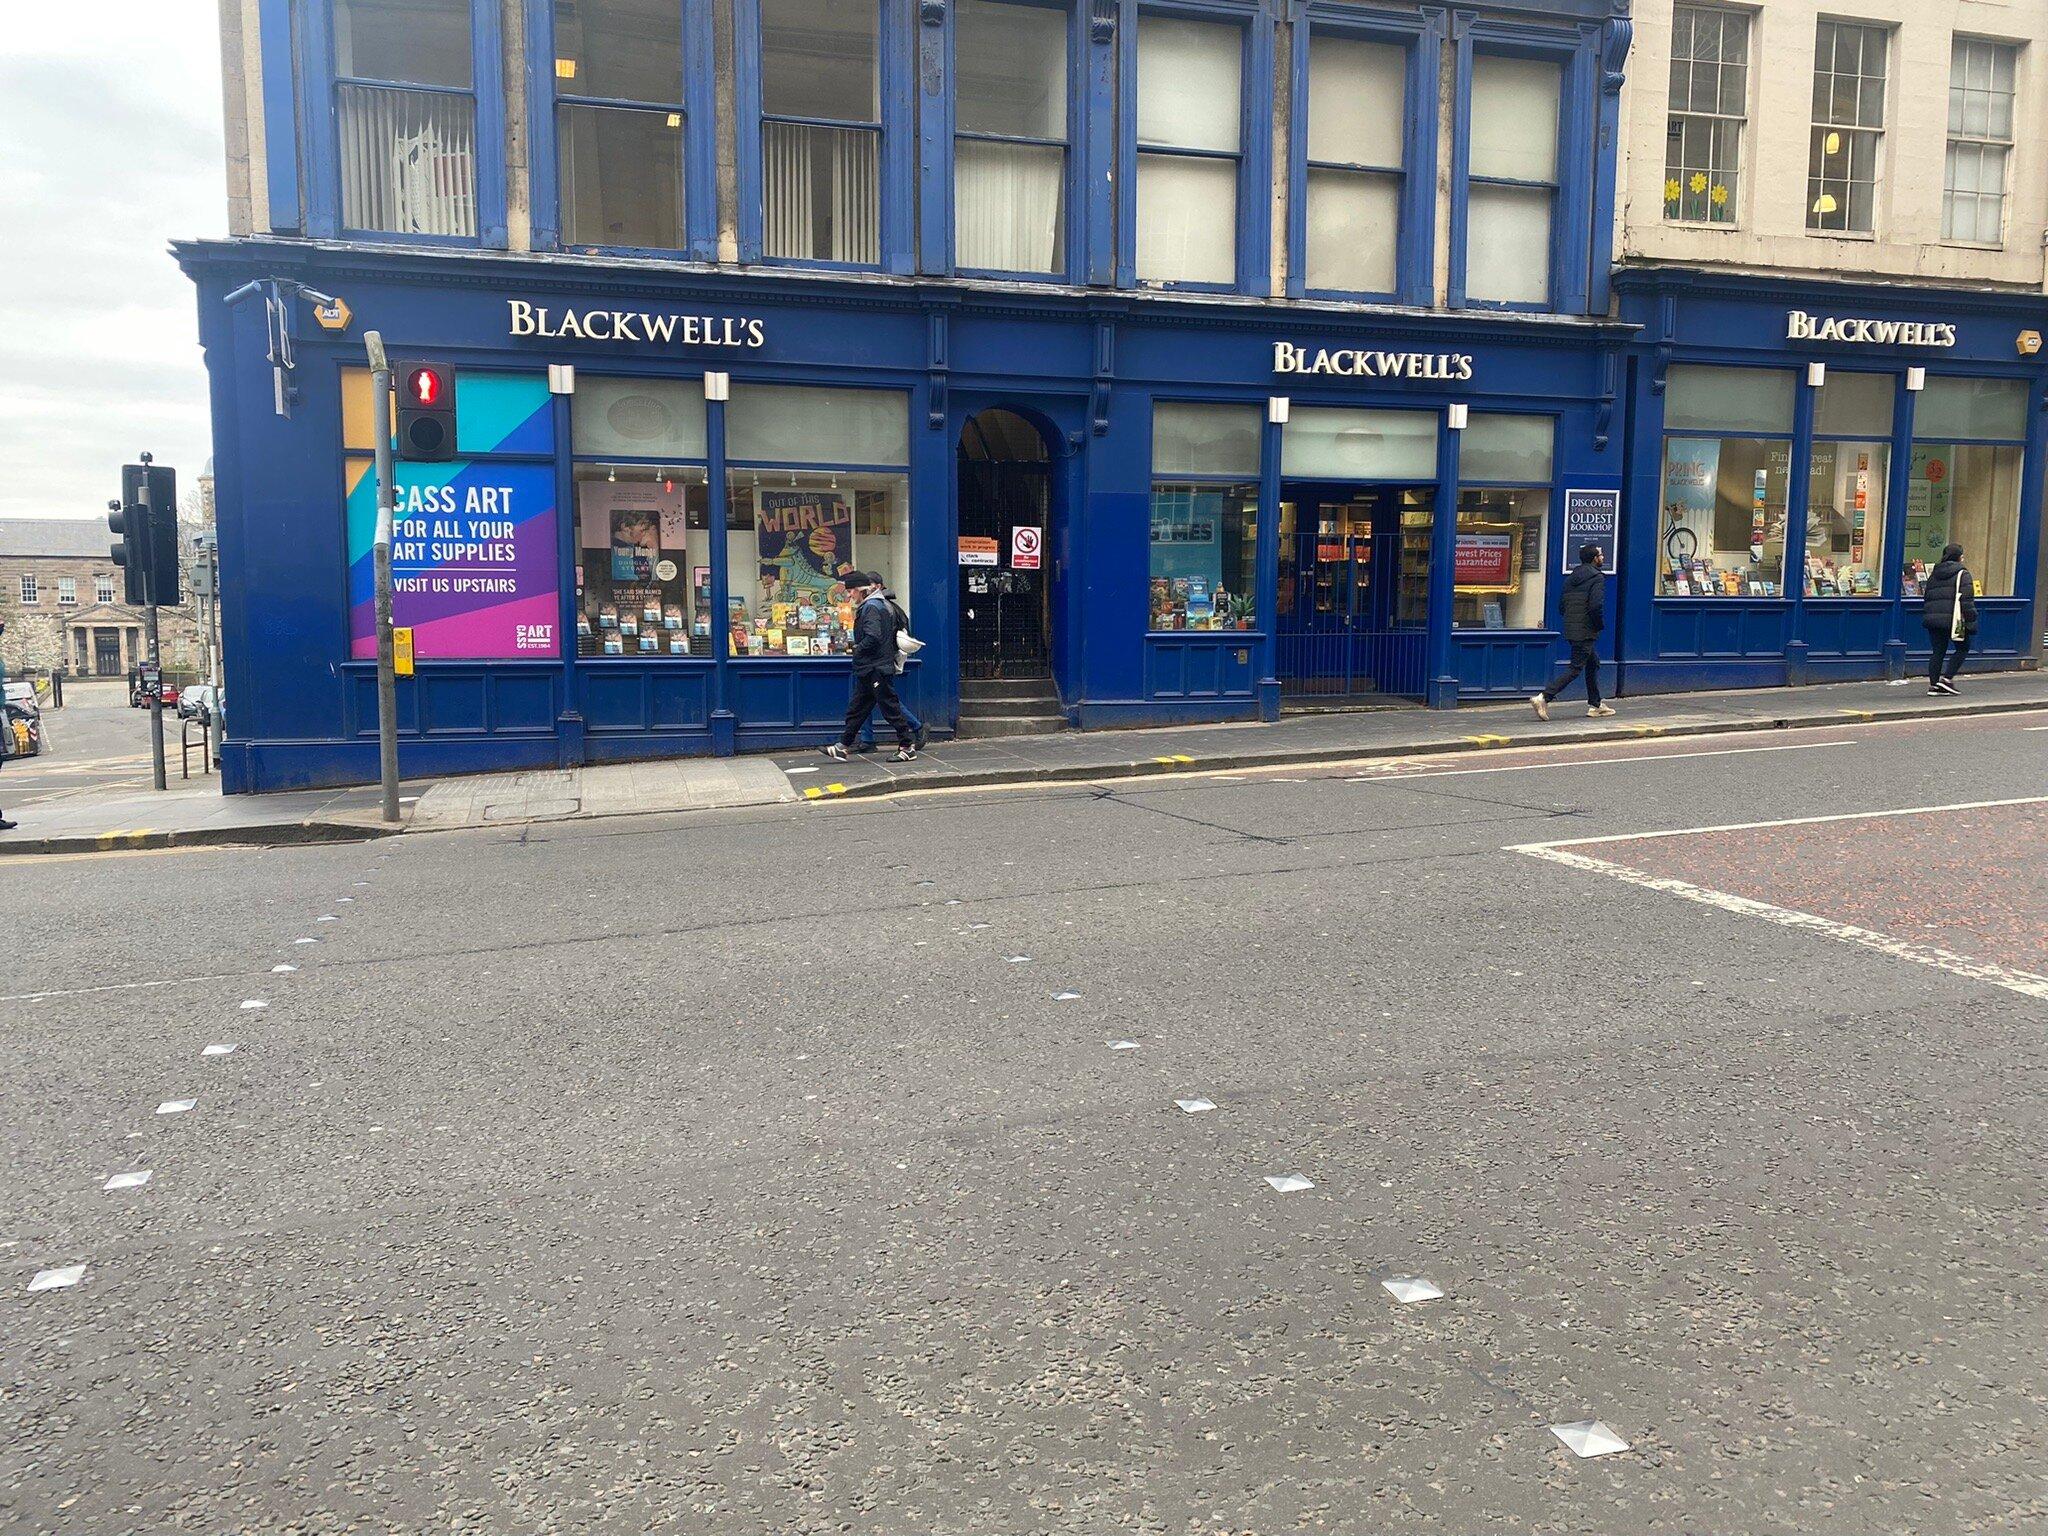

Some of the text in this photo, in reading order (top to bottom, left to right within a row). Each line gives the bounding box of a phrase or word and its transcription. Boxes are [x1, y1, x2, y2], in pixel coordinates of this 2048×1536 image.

[507, 299, 764, 348] BLACKWELL'S
[1786, 310, 1957, 347] BLACKWELL'S
[1272, 341, 1473, 380] BLACKWELL'S
[1771, 452, 1834, 463] Fin reat
[1810, 466, 1826, 475] ad!
[392, 485, 513, 514] CASS ART
[768, 496, 786, 508] OUT
[788, 495, 800, 507] OF
[1571, 499, 1613, 507] DISCOVER
[757, 501, 850, 532] WORLD
[1571, 513, 1613, 524] OLDEST
[392, 519, 515, 540] FOR ALL YOUR
[393, 543, 516, 562] ART SUPPLIES
[1480, 550, 1502, 558] Prices
[393, 578, 517, 593] VISIT US UPSTAIRS
[516, 624, 527, 649] CASS
[527, 624, 553, 638] ART
